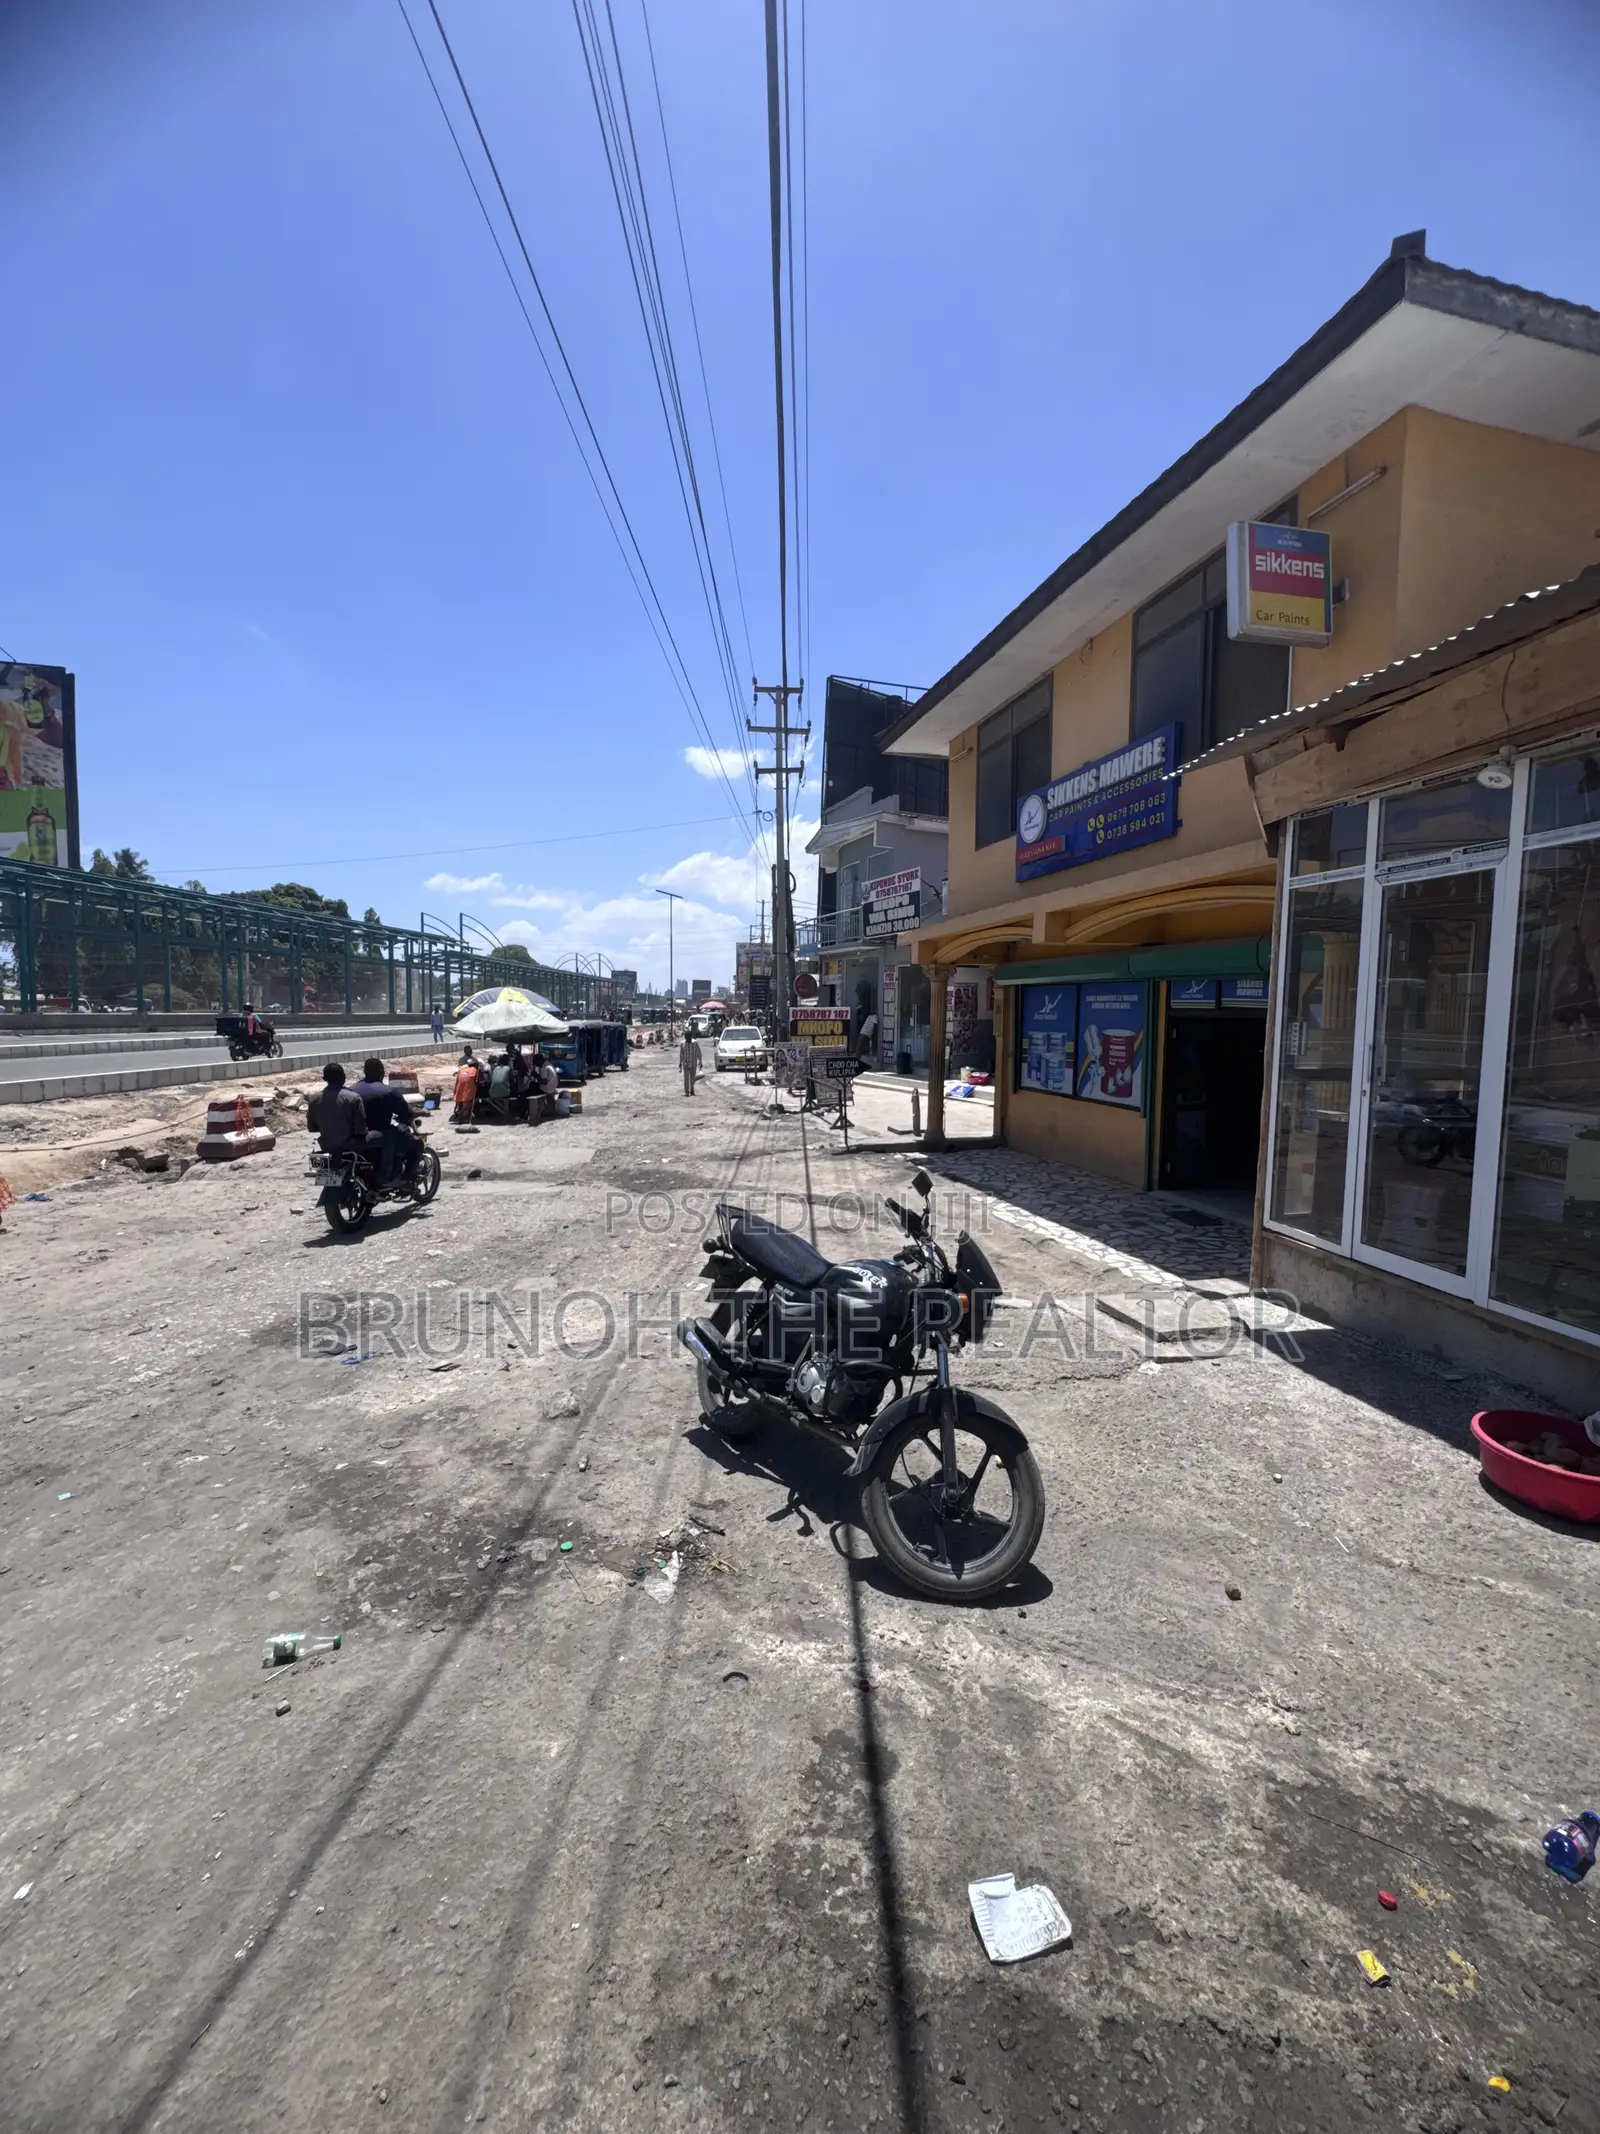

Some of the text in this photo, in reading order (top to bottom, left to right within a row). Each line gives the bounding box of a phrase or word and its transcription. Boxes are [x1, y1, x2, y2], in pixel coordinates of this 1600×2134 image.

[1255, 552, 1325, 579] sikkens
[1256, 609, 1310, 625] Car Paints
[1047, 736, 1165, 809] SIKKENS MAWERE
[1049, 809, 1064, 822] CAR
[1065, 799, 1092, 816] PAINTS
[1102, 768, 1164, 801] ACCESSORIES
[1149, 812, 1165, 826] 021
[897, 869, 920, 884] STORE
[869, 905, 915, 924] WA SIMU
[797, 1020, 843, 1035] MKOPO
[853, 1266, 888, 1289] BOXER
